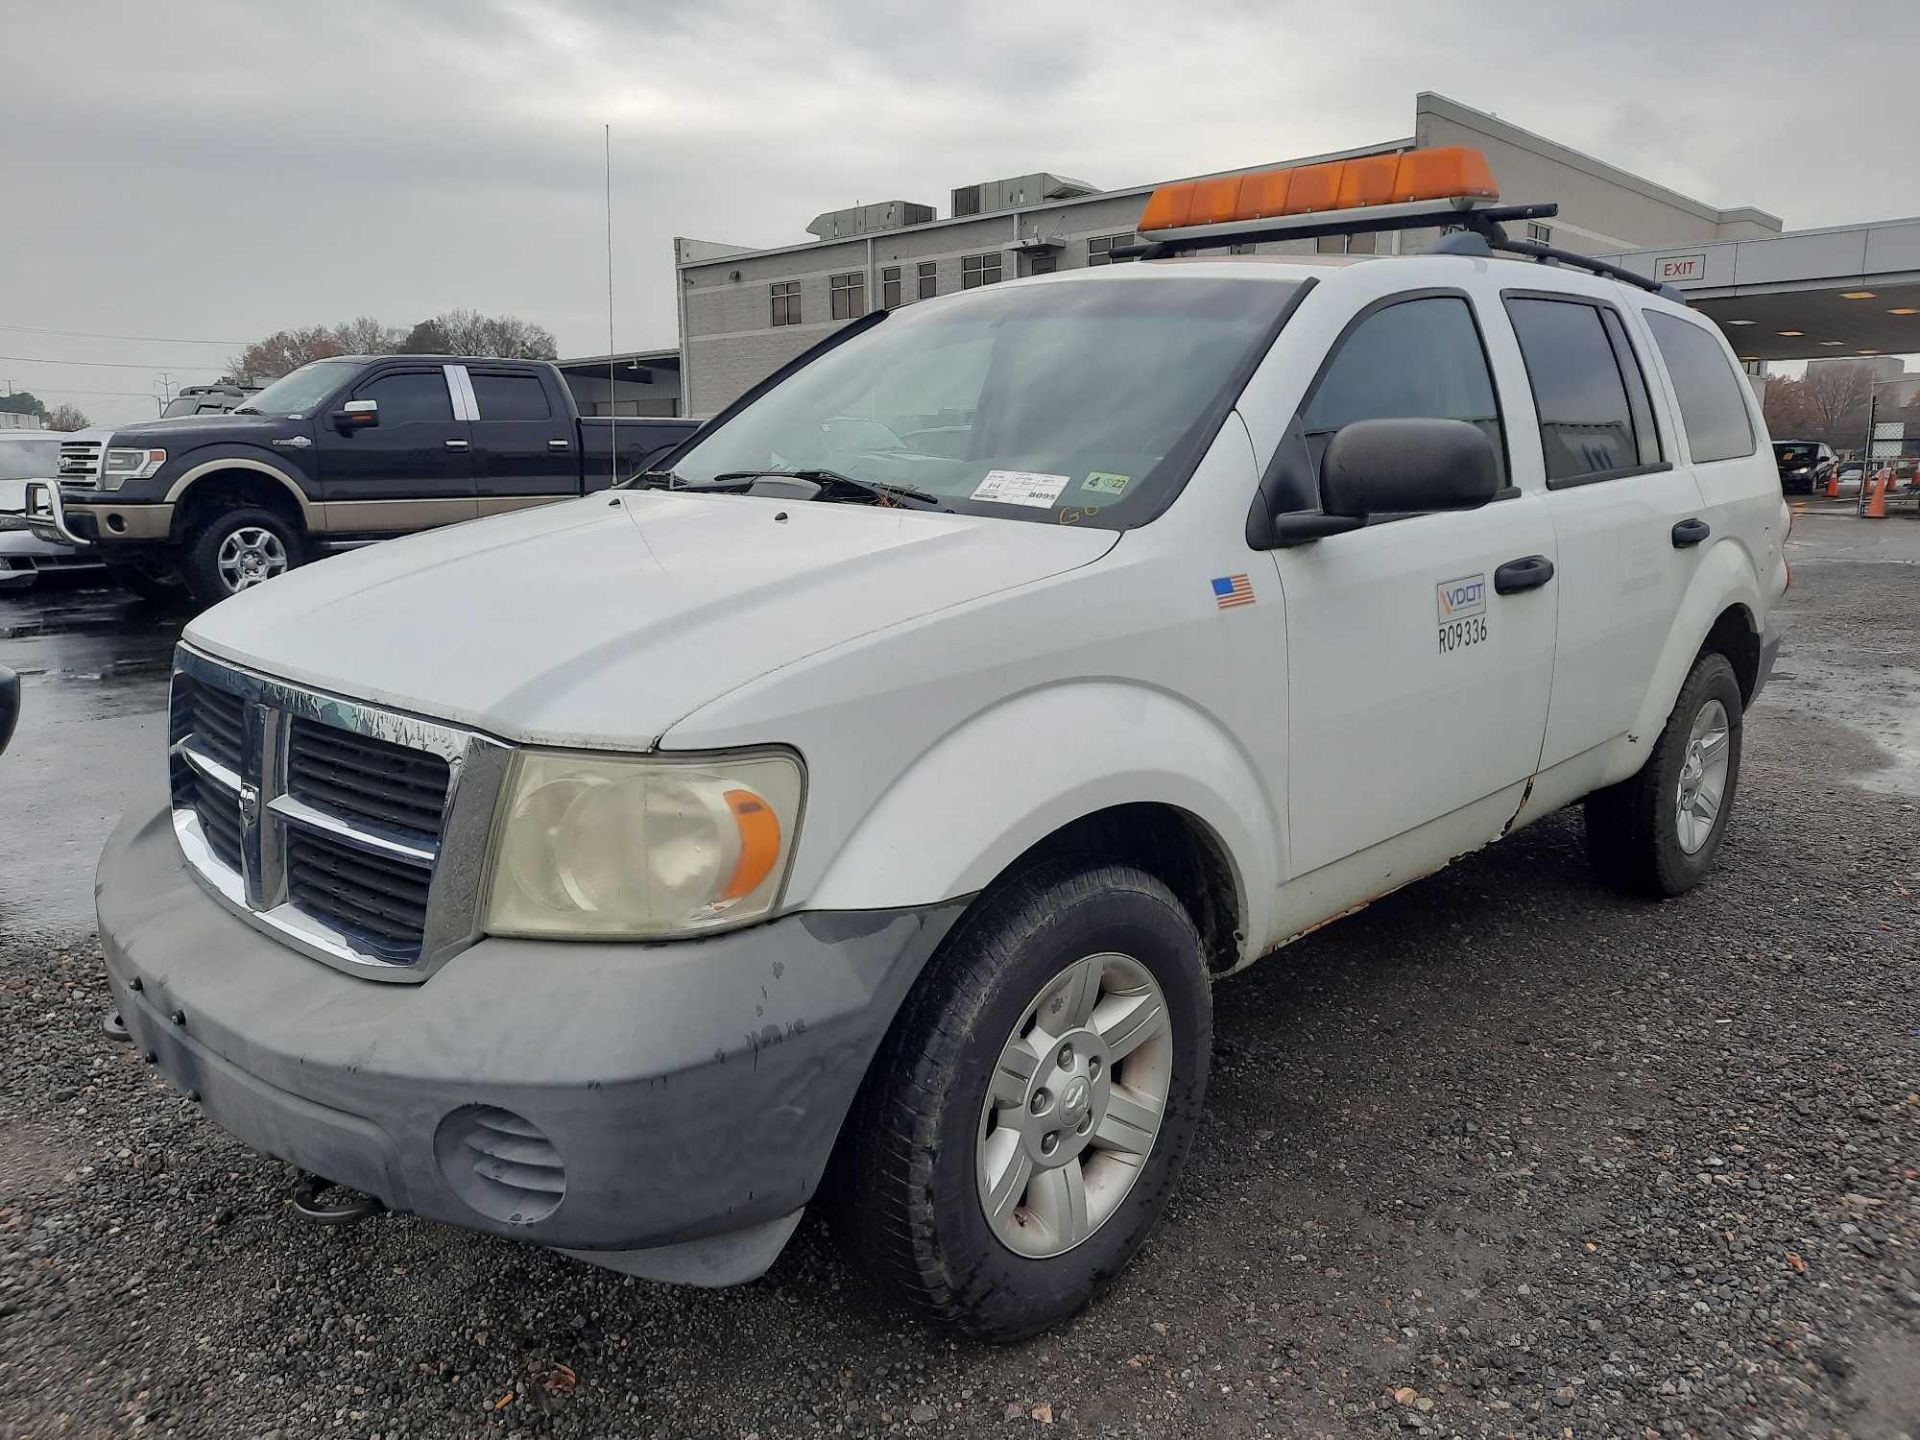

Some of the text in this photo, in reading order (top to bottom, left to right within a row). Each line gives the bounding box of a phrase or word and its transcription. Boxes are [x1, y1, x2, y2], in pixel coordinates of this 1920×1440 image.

[1664, 261, 1696, 276] EXIT
[1089, 477, 1126, 488] 4 22
[1029, 492, 1057, 500] 8095
[1446, 583, 1483, 606] VDOT
[1438, 617, 1488, 655] R09336
